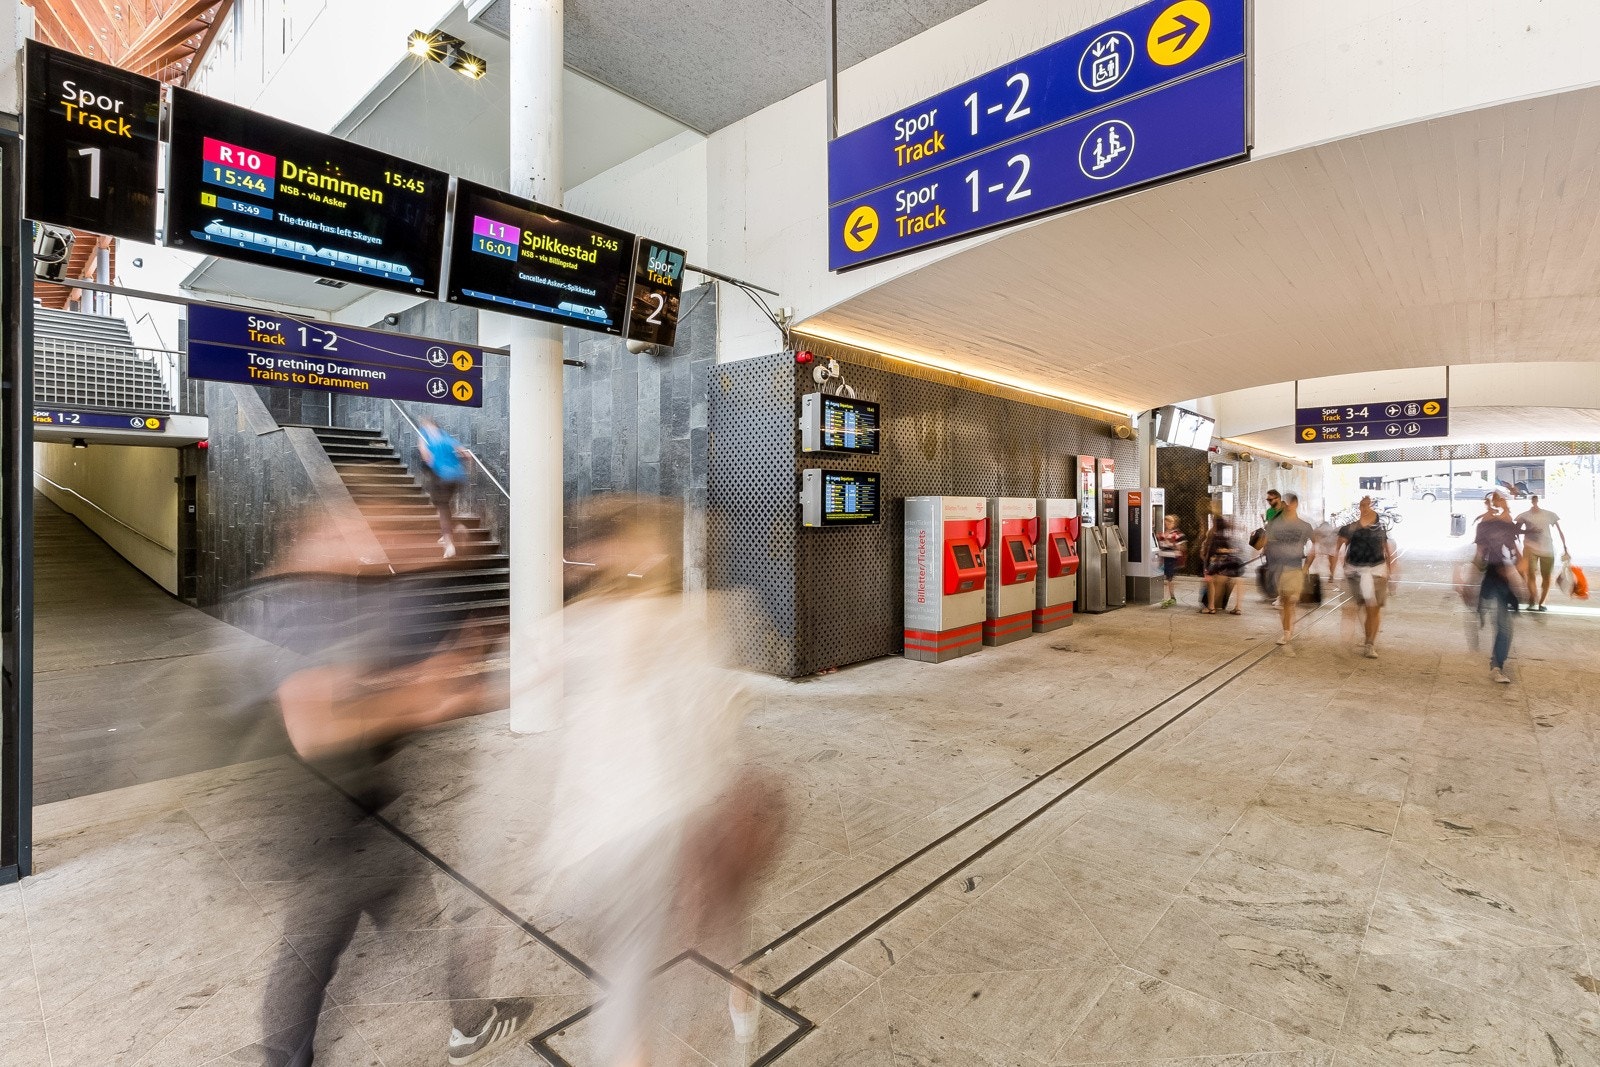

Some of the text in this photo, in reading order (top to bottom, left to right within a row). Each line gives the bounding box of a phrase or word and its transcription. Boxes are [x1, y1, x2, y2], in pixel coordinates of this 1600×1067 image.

[61, 80, 124, 114] Spor
[964, 72, 1031, 136] 1-2
[60, 101, 132, 139] Track
[894, 108, 937, 142] Spor
[894, 130, 945, 167] Track
[78, 147, 100, 200] 1
[213, 168, 267, 193] 15:44
[282, 160, 383, 204] Drammen
[384, 171, 425, 193] 15:45
[965, 153, 1032, 213] 1-2
[231, 202, 260, 215] 15:49
[280, 184, 299, 196] NSB
[308, 192, 321, 202] via
[322, 196, 347, 209] Asker
[895, 183, 938, 213] Spor
[895, 204, 946, 238] Track
[479, 239, 512, 257] 16:01
[521, 249, 534, 259] NSB
[539, 254, 548, 262] via
[522, 230, 598, 264] Spikkestad
[590, 235, 618, 251] 15:45
[649, 257, 672, 273] Spor
[648, 269, 673, 287] Track
[645, 293, 664, 325] 2
[248, 316, 281, 332] Spor
[248, 330, 286, 346] Track
[298, 326, 338, 351] 1-2
[248, 352, 386, 380] Tog retning Drammen
[248, 366, 369, 390] Trains to Drammen
[57, 412, 80, 424] 1-2
[1345, 406, 1369, 419] 3-4
[1345, 425, 1369, 438] 3-4
[917, 529, 926, 604] Billetter/Tickets
